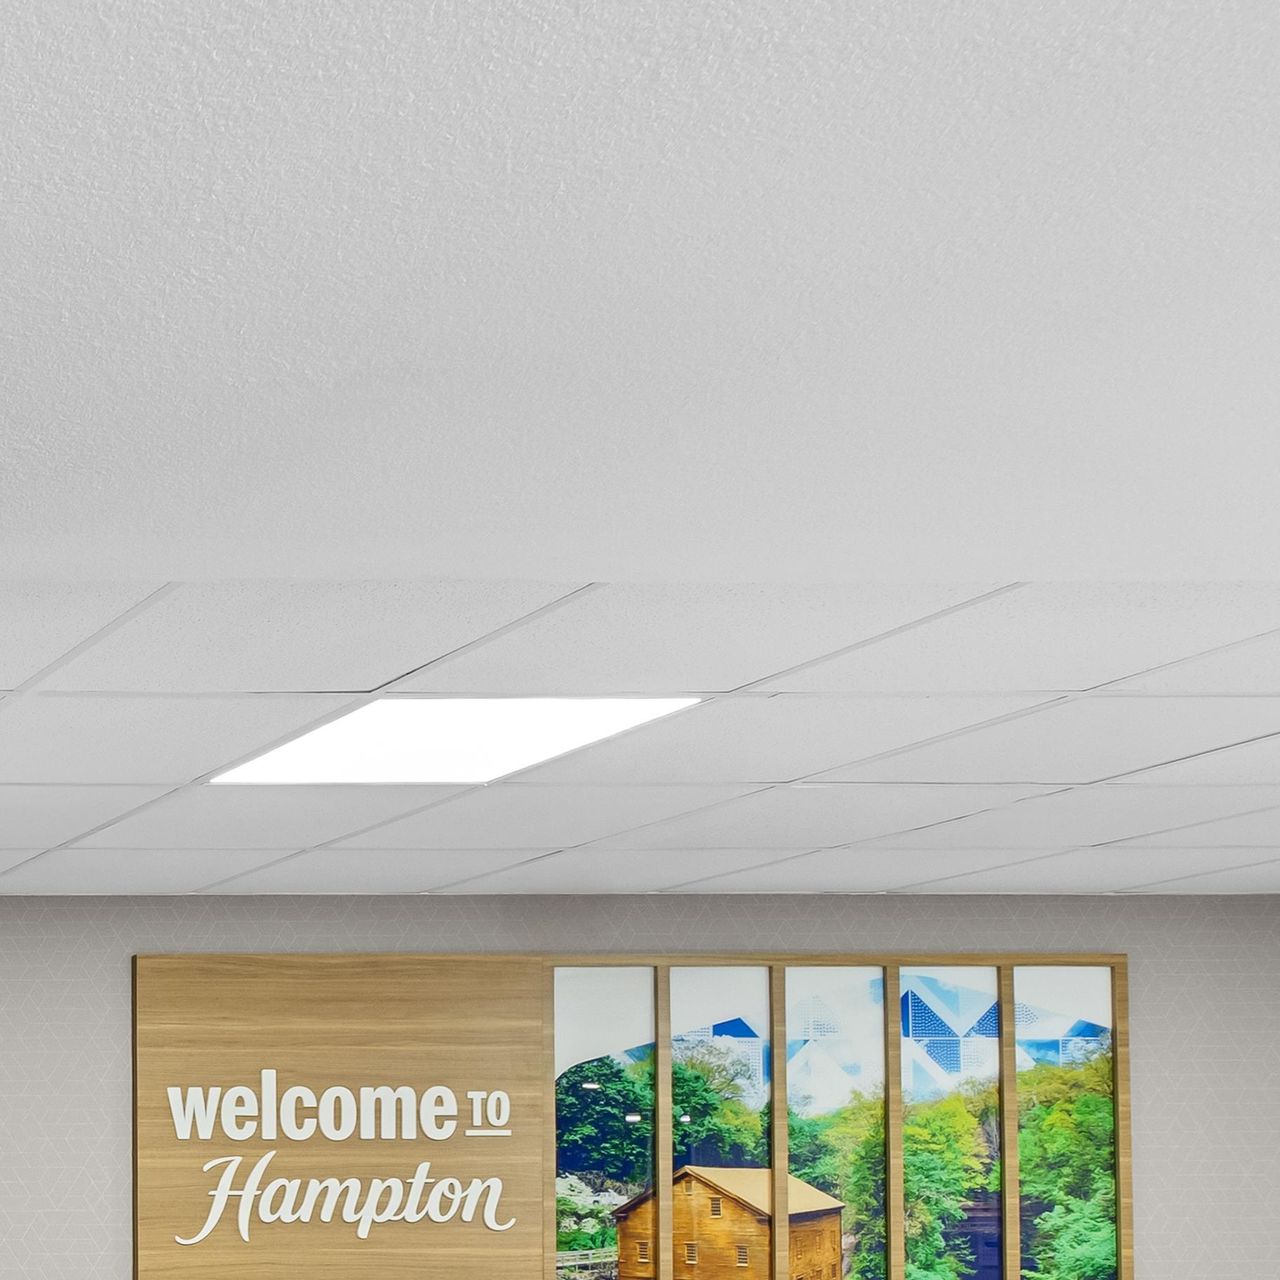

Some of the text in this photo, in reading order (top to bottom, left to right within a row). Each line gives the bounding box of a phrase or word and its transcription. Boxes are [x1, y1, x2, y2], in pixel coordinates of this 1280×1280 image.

[167, 1068, 512, 1142] welcome TO
[175, 1151, 516, 1246] Hampton
